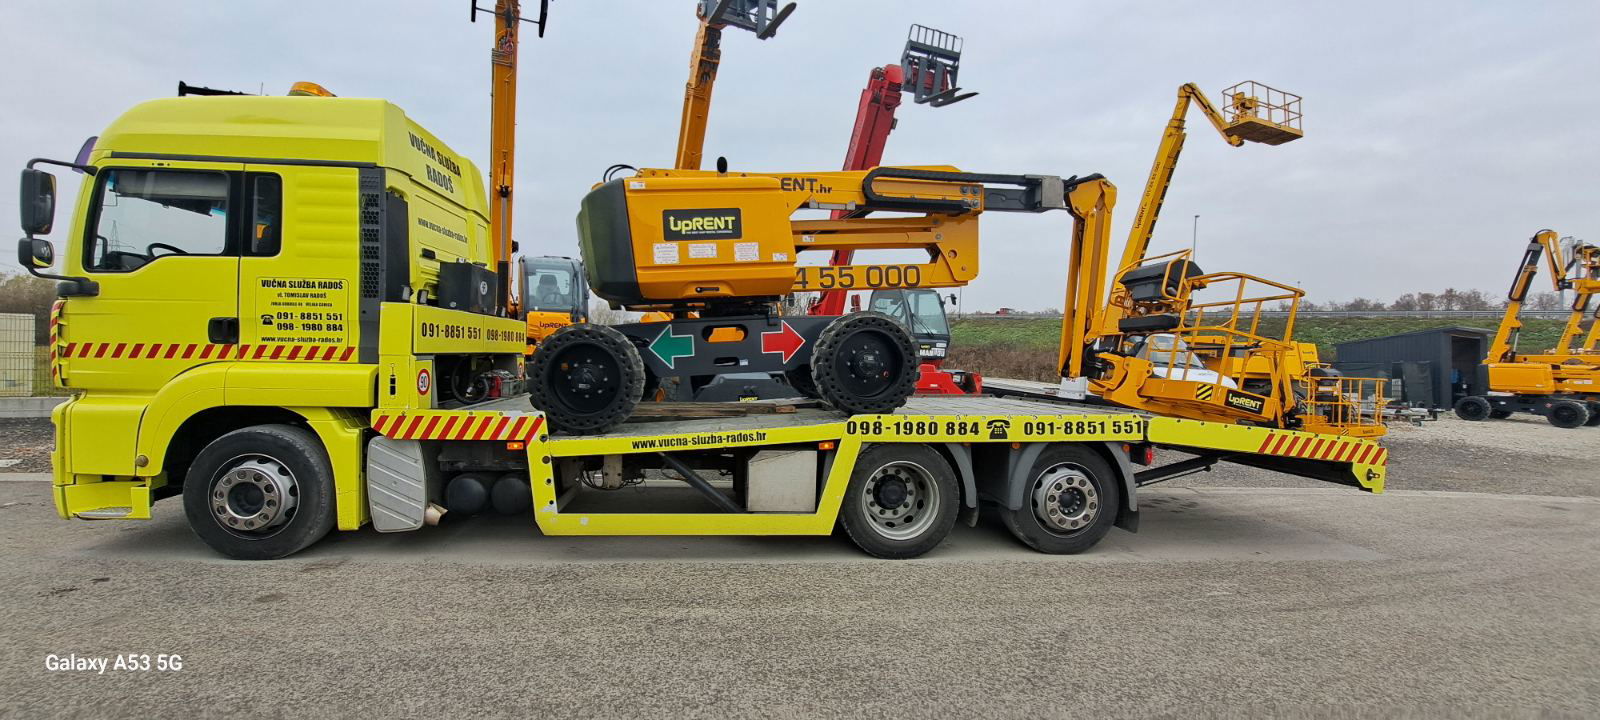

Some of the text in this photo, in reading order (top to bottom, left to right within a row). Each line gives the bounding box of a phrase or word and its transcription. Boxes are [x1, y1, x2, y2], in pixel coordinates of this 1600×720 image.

[408, 131, 462, 177] VUČNA SLUŽBA
[425, 163, 454, 193] RADOŠ
[780, 177, 833, 194] ENT.hr
[261, 279, 343, 290] VUČNA SLUŽBA RADOŠ
[819, 266, 855, 288] 55
[866, 265, 921, 288] 000
[326, 313, 343, 321] 551
[326, 323, 343, 332] 884
[421, 322, 482, 340] 091-8851 551
[486, 328, 525, 342] 098-1980 884
[419, 376, 428, 389] 90
[846, 420, 980, 436] 098-1980 884
[1023, 419, 1142, 436] 091-8851 551
[632, 431, 767, 450] www.vucna-sluzba-rados.hr
